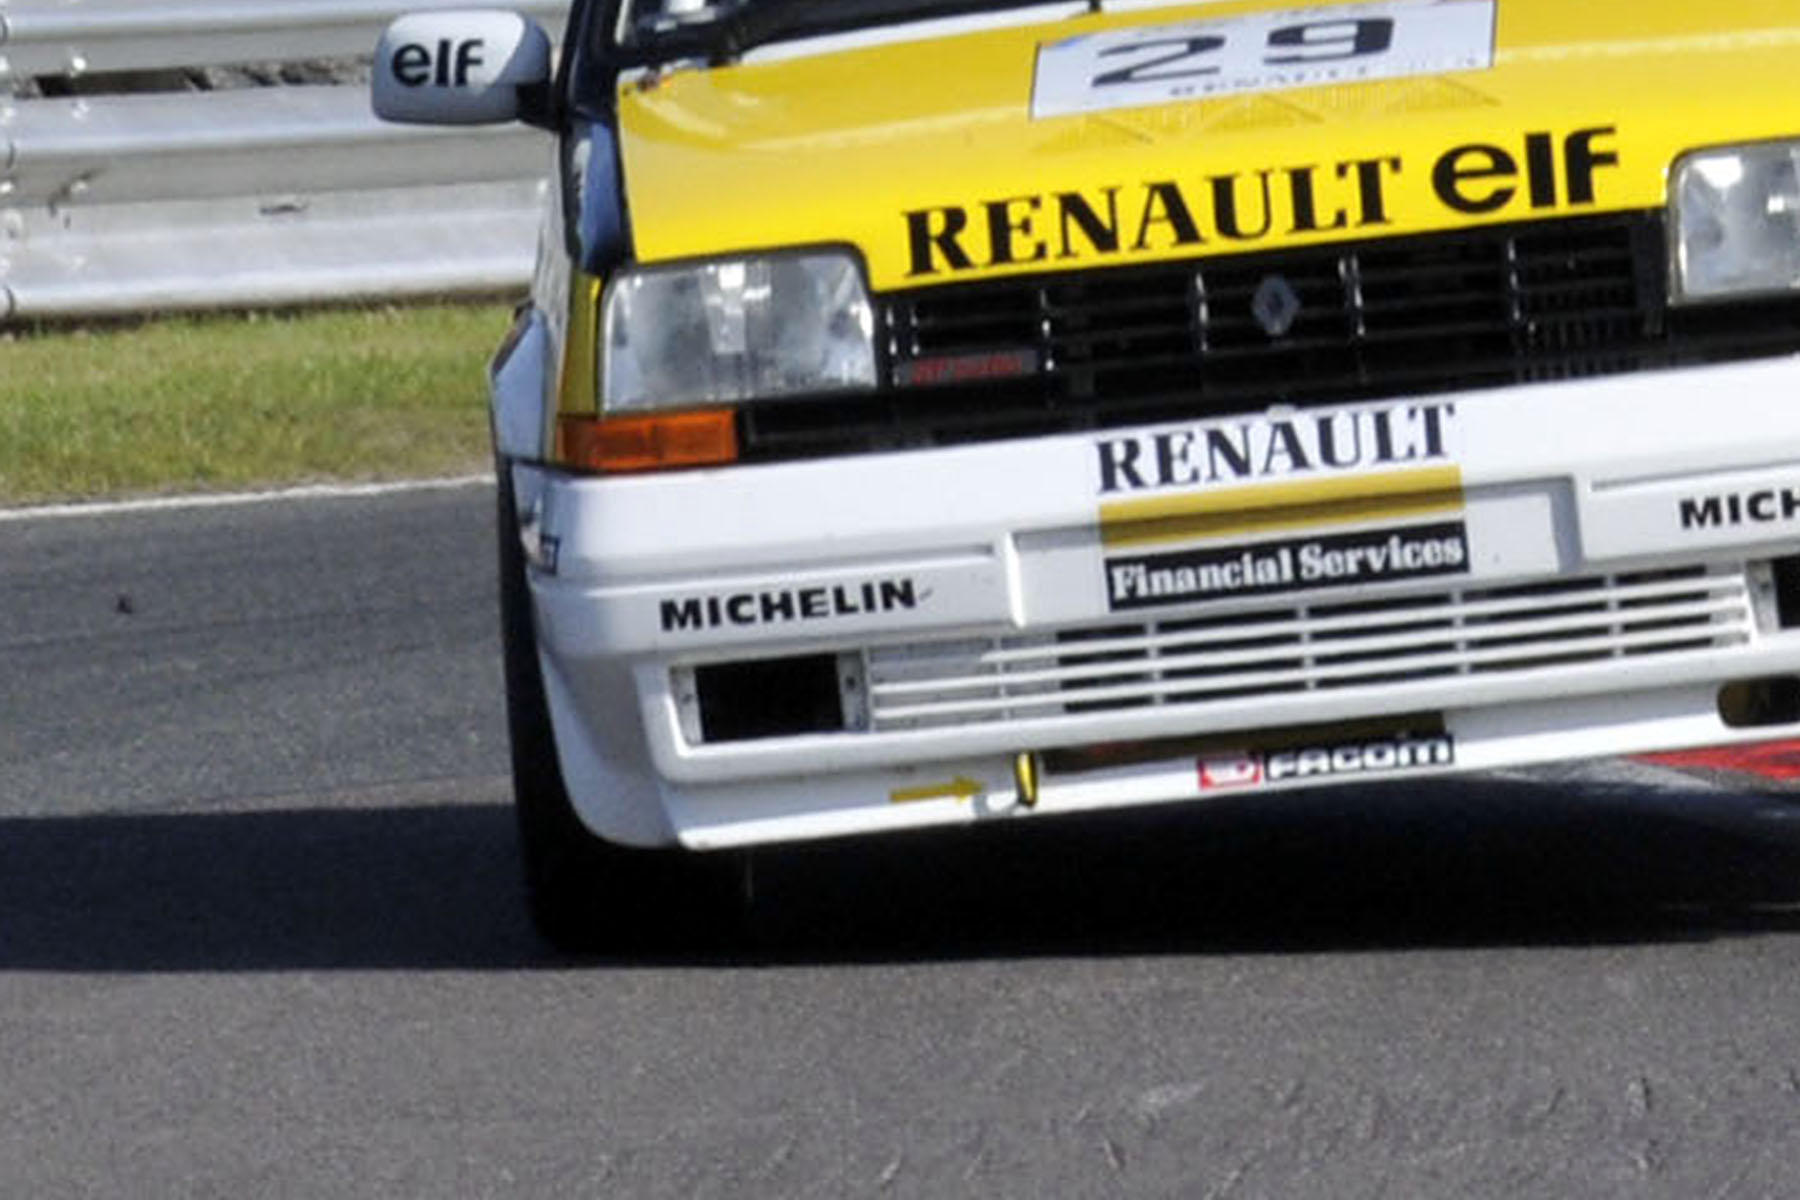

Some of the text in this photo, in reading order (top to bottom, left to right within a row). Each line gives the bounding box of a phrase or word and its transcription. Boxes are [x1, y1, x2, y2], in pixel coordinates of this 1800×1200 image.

[390, 37, 486, 88] elf
[1091, 16, 1396, 88] 29
[900, 124, 1620, 280] RENAULT elf
[1094, 402, 1457, 497] RENAULT
[1110, 534, 1465, 601] Financial Services
[659, 577, 918, 632] MICHELIN
